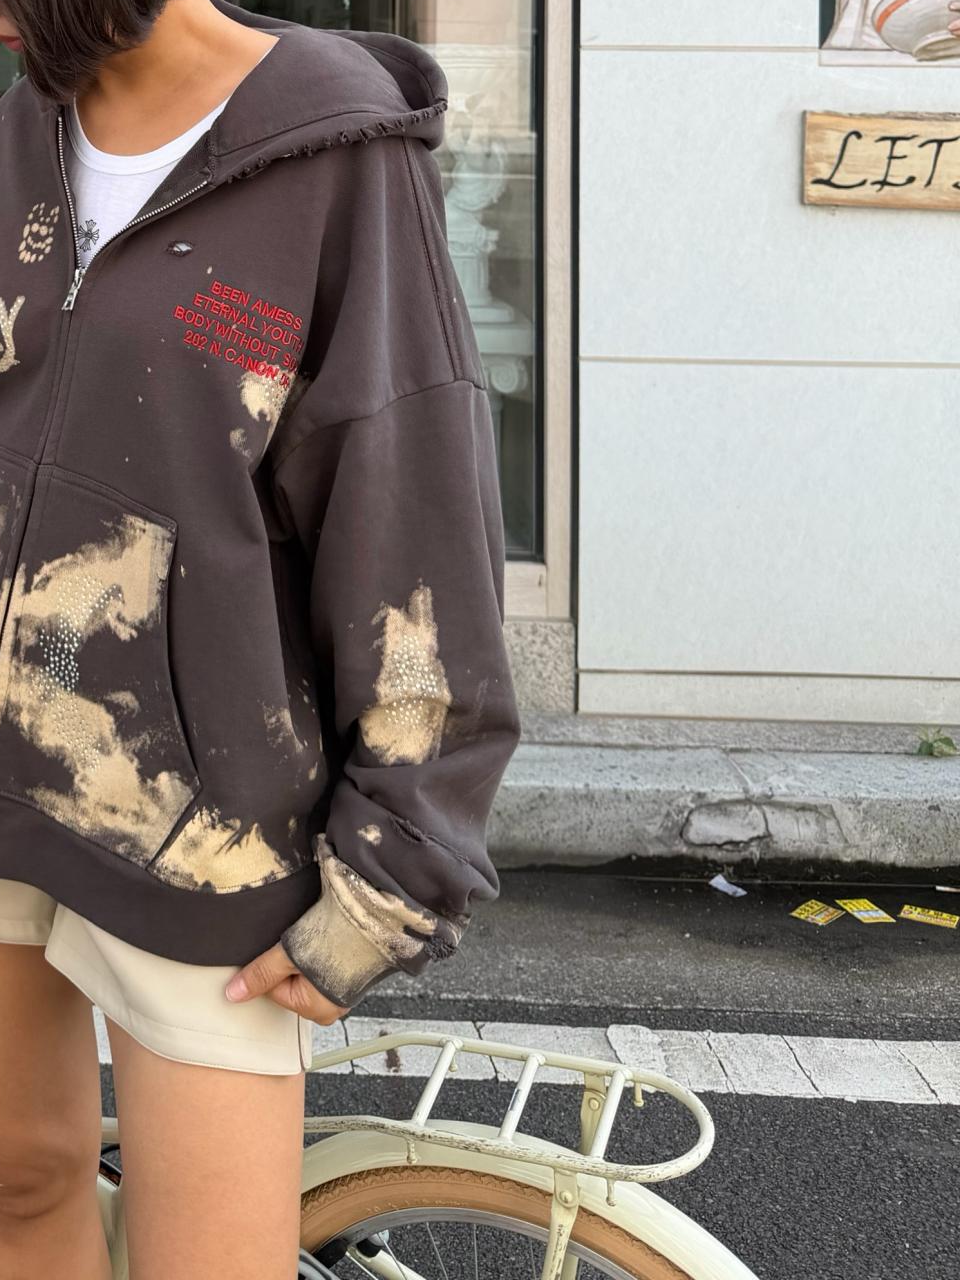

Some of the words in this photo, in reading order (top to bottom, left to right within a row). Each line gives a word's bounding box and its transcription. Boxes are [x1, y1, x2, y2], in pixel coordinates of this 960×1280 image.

[811, 130, 960, 192] LET
[193, 292, 258, 332] ETERNAL
[259, 320, 304, 353] YOUTH
[210, 280, 251, 308] BEEN
[251, 299, 303, 331] AMESS
